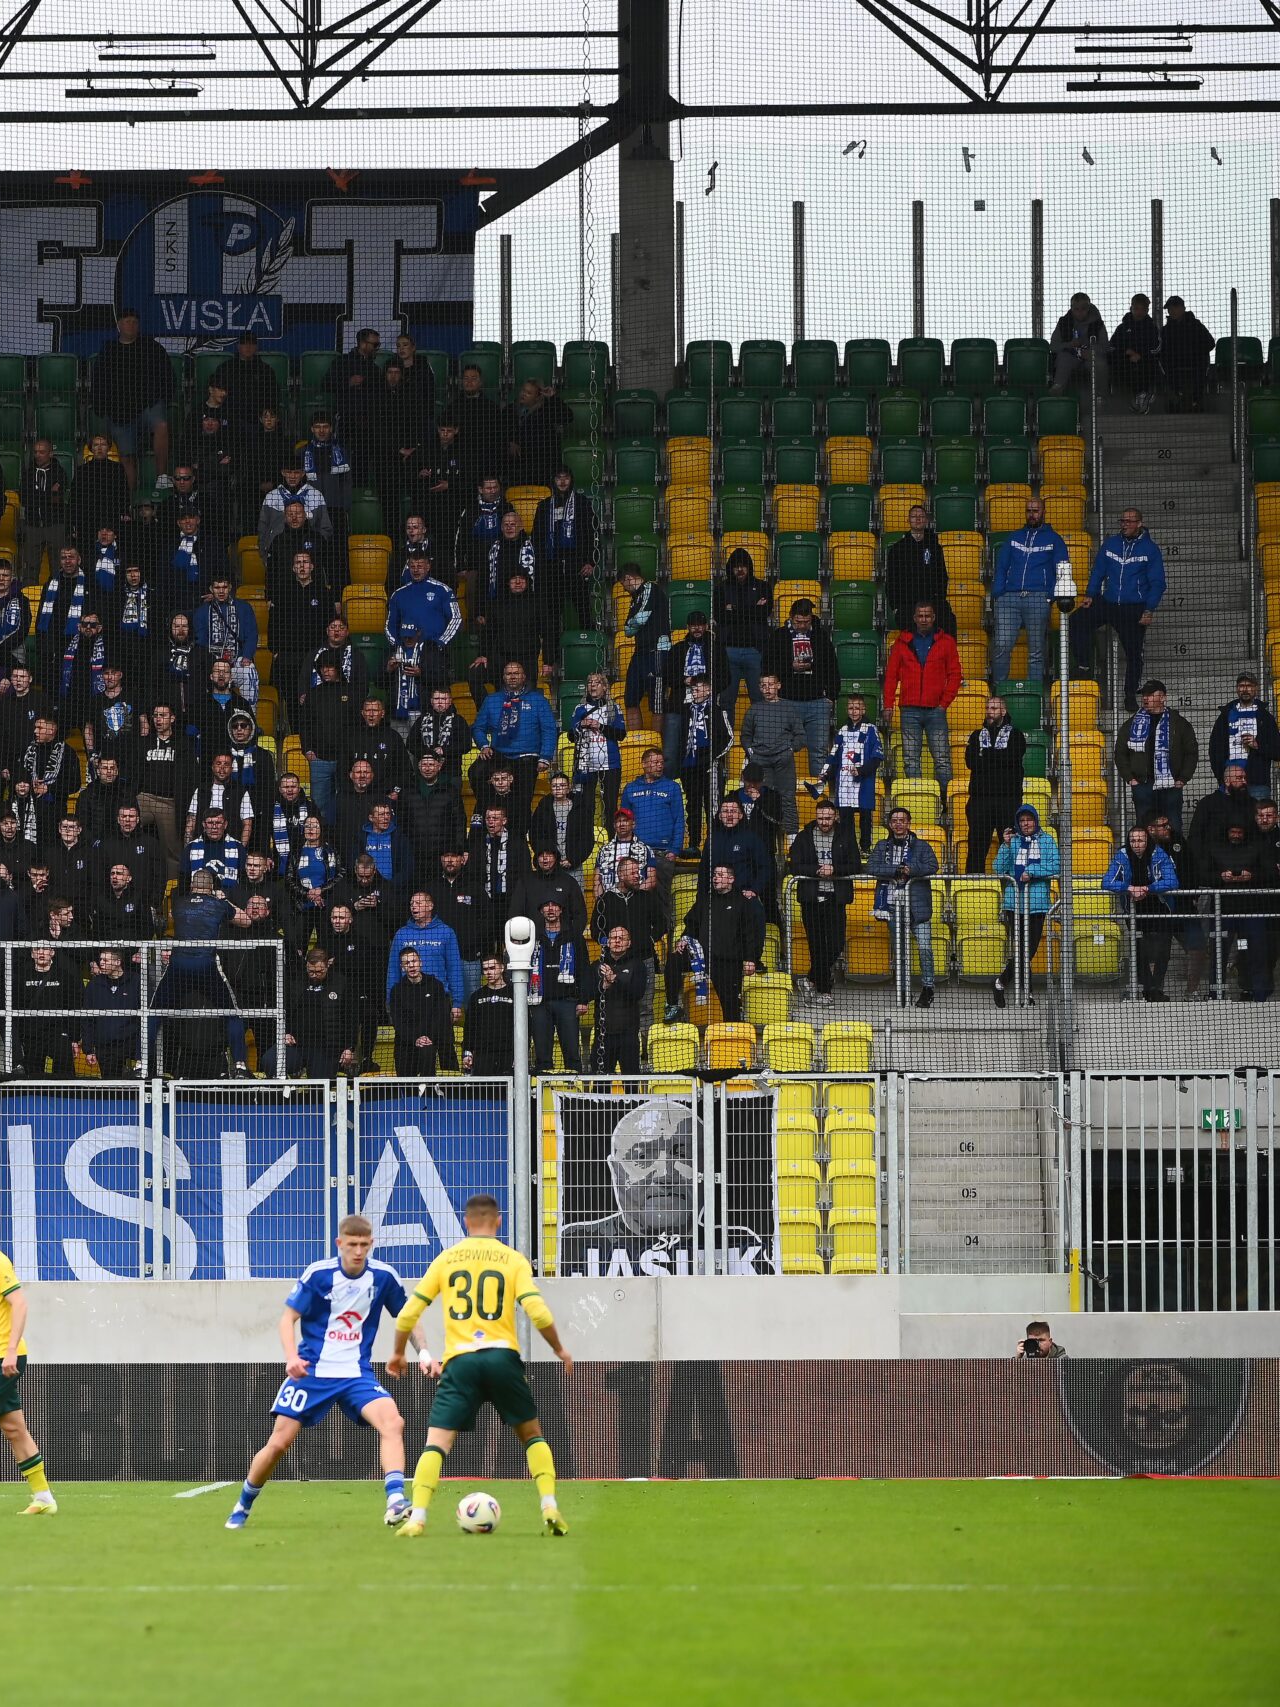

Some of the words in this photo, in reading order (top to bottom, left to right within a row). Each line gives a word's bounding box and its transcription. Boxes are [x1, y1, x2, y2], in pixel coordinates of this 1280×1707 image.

[165, 221, 178, 273] ZKS
[160, 300, 273, 332] WISŁA
[1158, 449, 1172, 460] 20
[1179, 696, 1192, 707] 15
[959, 1141, 975, 1153] 06
[961, 1187, 977, 1199] 05
[965, 1235, 980, 1246] 04
[570, 1245, 764, 1277] JASIK
[448, 1269, 506, 1321] 30
[328, 1329, 361, 1342] ORLEN
[277, 1384, 309, 1413] 30
